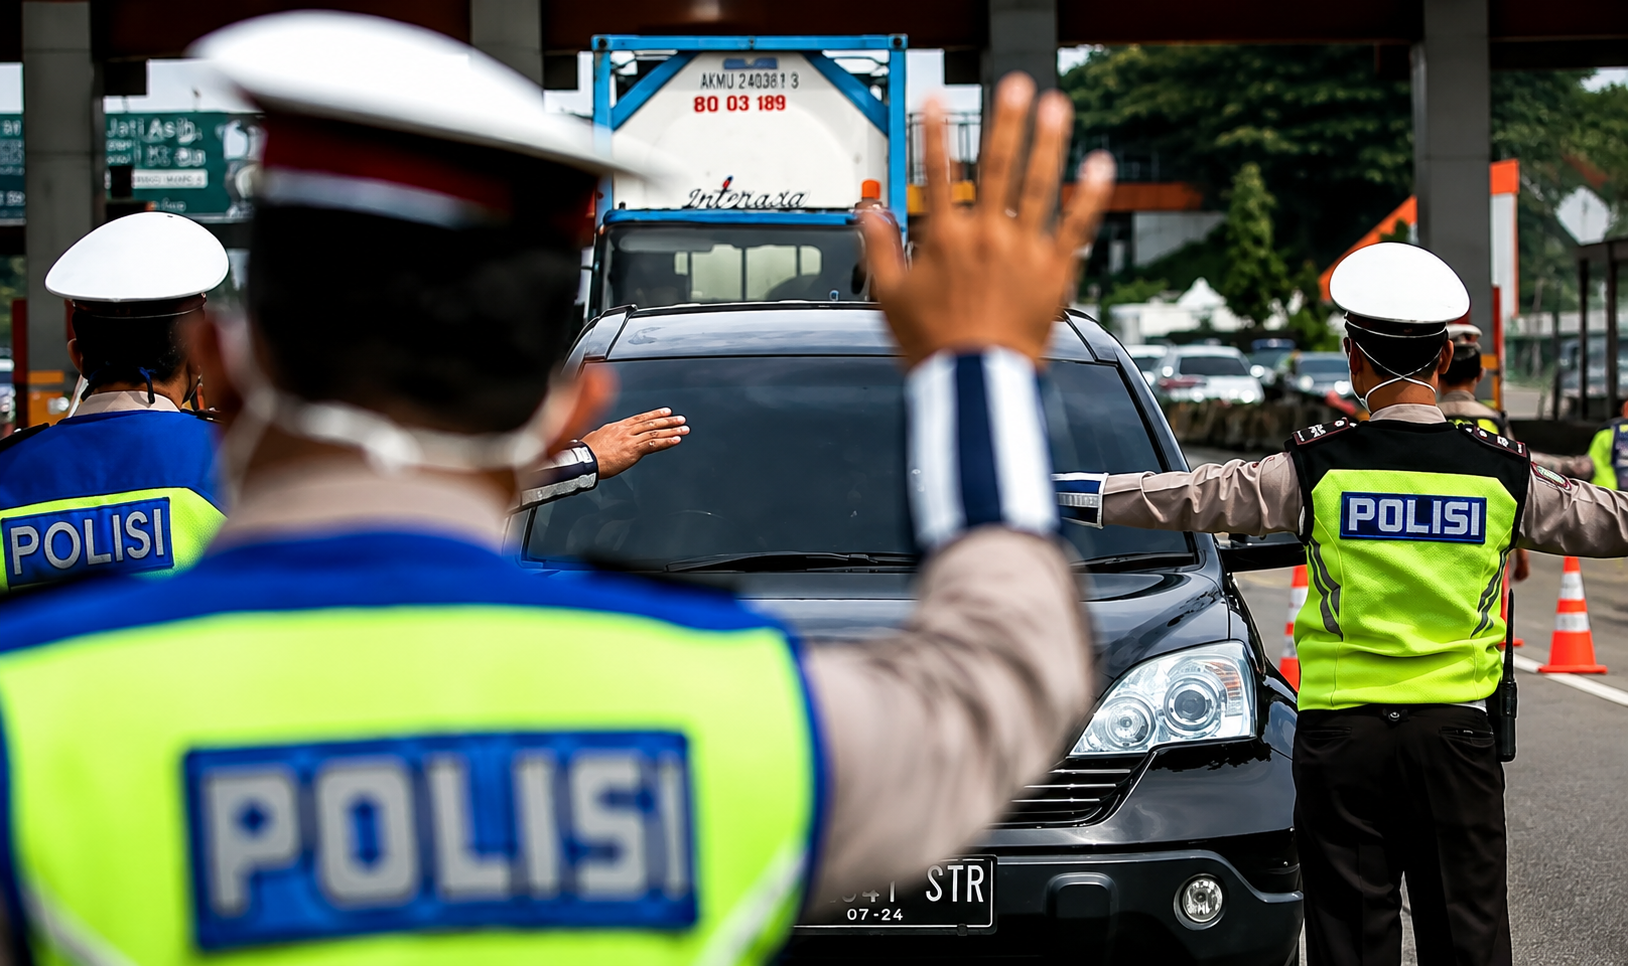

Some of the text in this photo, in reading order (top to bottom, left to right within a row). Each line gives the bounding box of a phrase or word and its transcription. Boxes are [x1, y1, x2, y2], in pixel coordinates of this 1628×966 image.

[700, 72, 734, 89] AKMU
[694, 94, 787, 113] 80 03 189
[1348, 497, 1480, 536] POLISI
[10, 508, 165, 576] POLISI
[205, 750, 686, 917] POLISI
[925, 864, 985, 903] STR
[846, 908, 904, 921] 07-24
